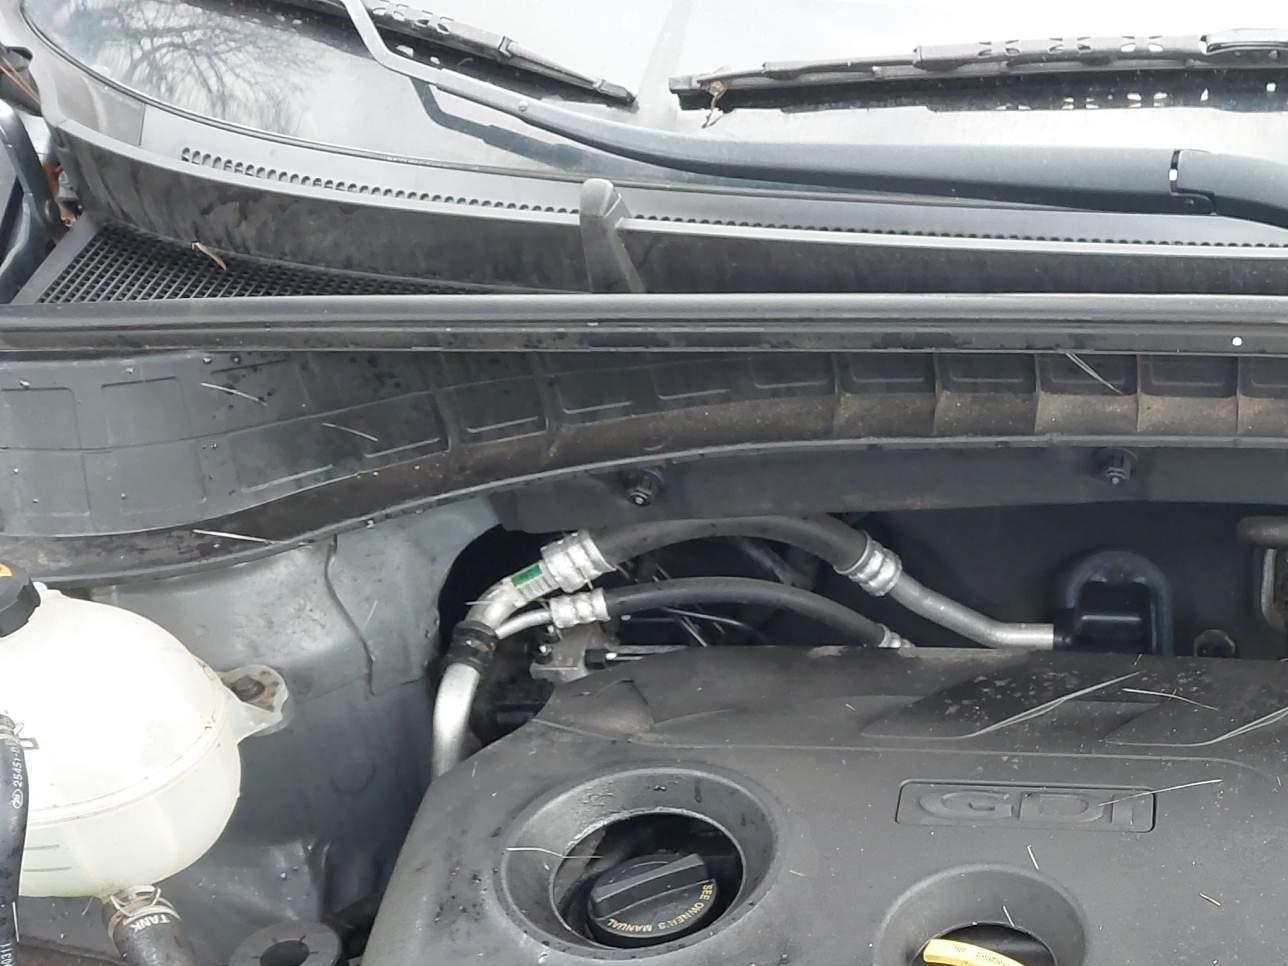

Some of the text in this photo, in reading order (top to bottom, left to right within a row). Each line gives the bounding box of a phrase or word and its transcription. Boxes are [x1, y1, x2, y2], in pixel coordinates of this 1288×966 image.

[917, 788, 1133, 826] GDI
[130, 914, 170, 933] TANK
[606, 884, 714, 933] SEE OWNER'S MANUAL
